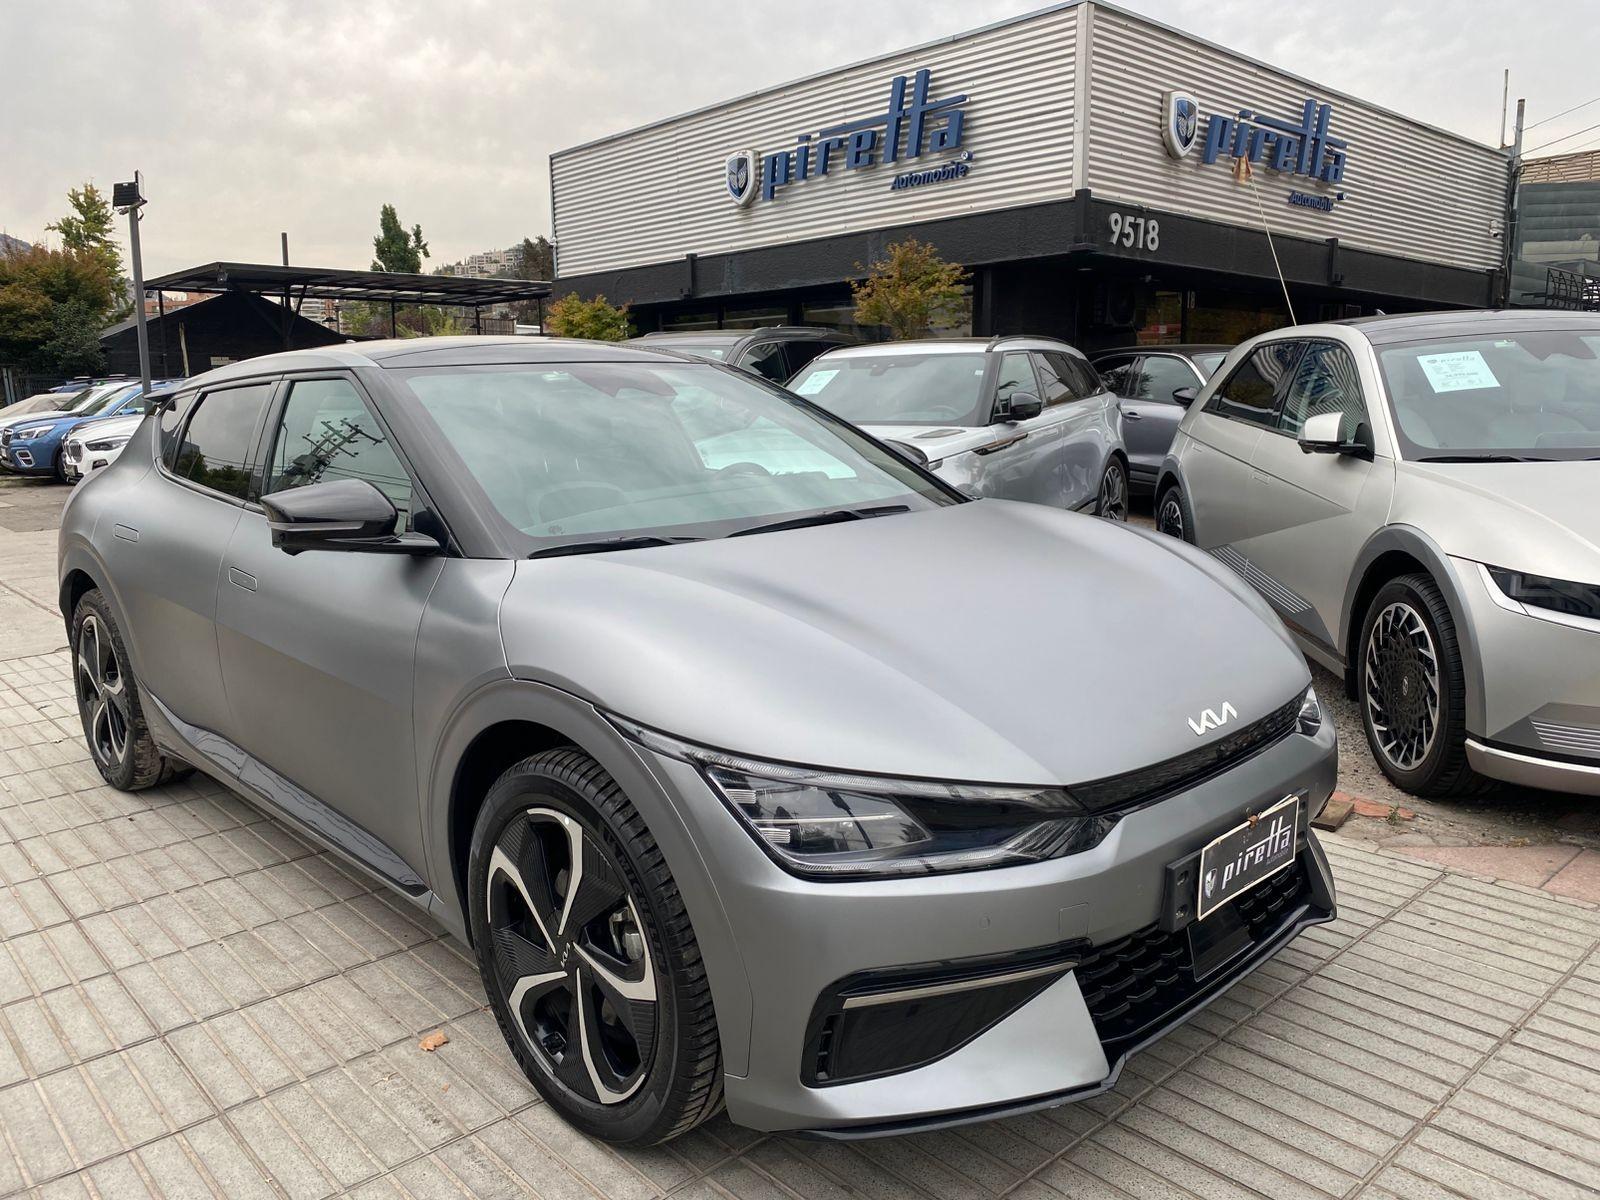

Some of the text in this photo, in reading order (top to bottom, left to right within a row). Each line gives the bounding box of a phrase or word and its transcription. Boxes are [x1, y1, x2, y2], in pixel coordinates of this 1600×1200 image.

[762, 69, 967, 200] piretta
[1203, 99, 1347, 183] piretta
[891, 161, 967, 190] Automobile
[1222, 816, 1291, 889] piretta
